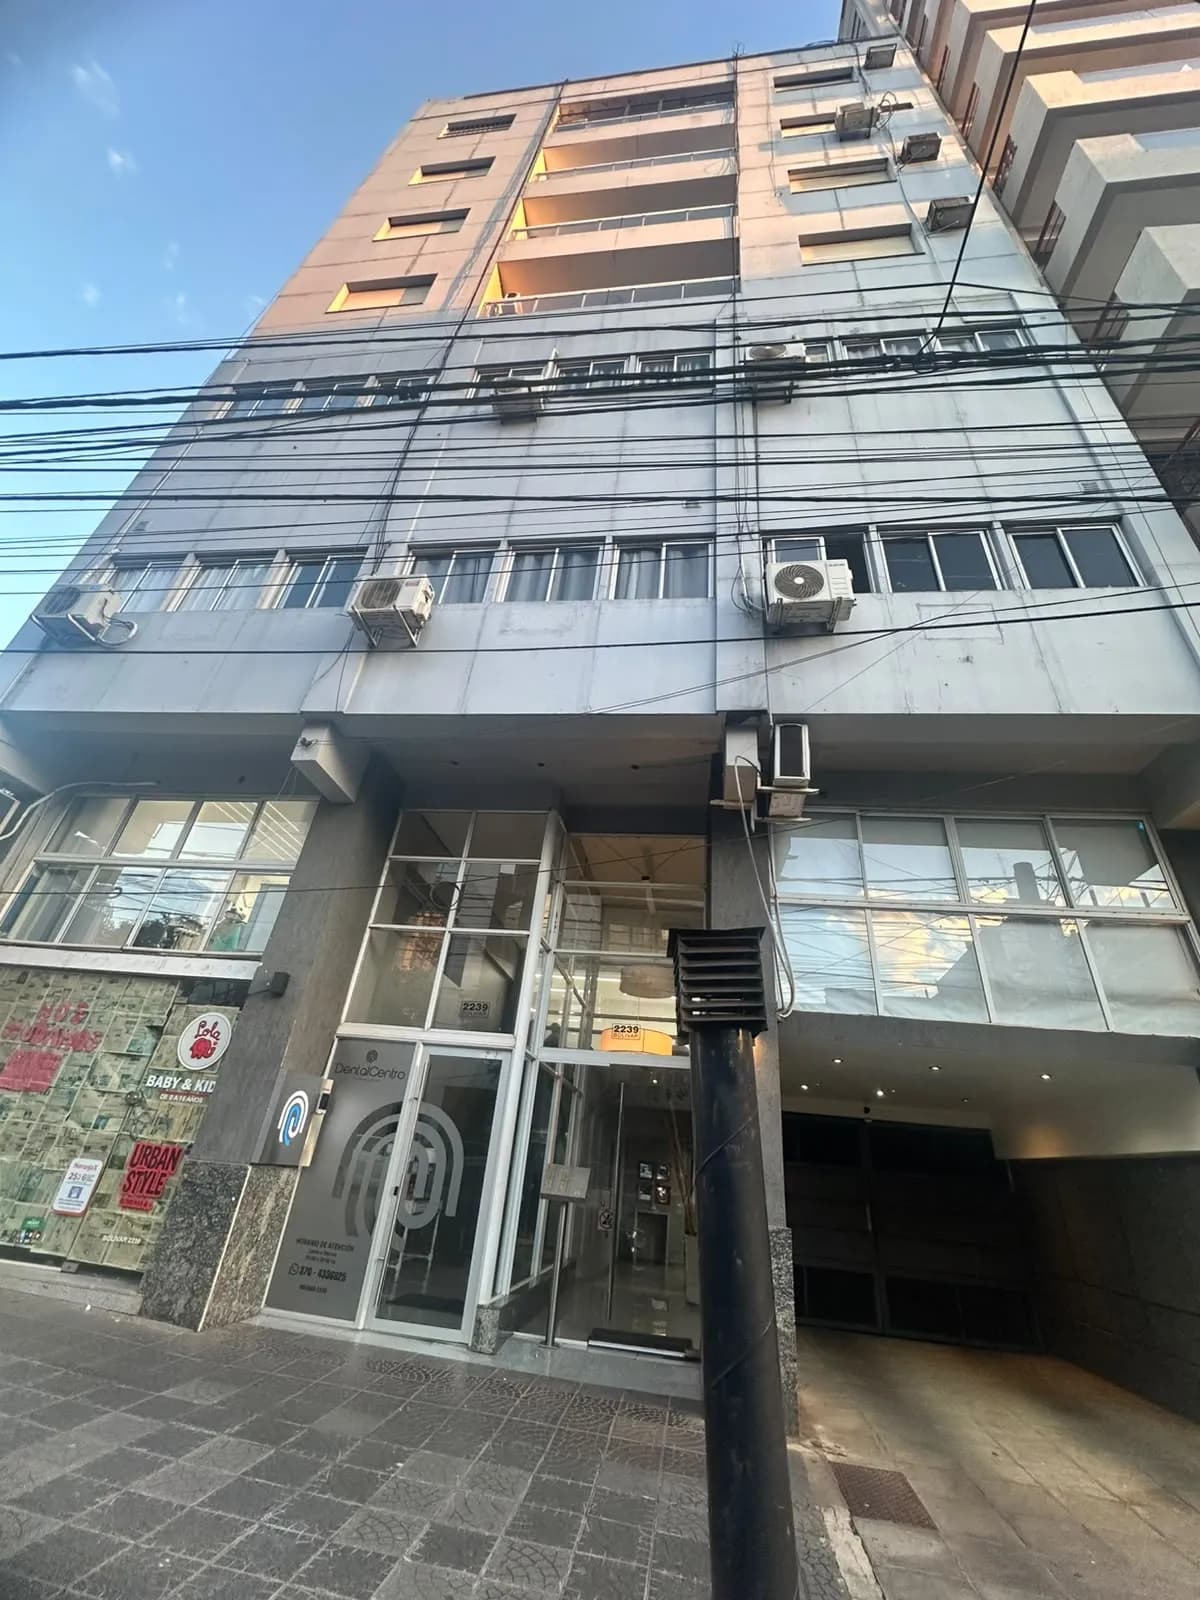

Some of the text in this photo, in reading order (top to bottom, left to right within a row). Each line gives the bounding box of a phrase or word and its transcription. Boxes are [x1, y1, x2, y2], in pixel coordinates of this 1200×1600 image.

[462, 1002, 489, 1012] 2239
[194, 1020, 221, 1041] Lola
[613, 1024, 640, 1034] 2239
[335, 1062, 406, 1080] DentalCentro
[145, 1075, 181, 1090] BABY
[128, 1143, 183, 1172] URBAN
[122, 1170, 168, 1195] STYLE
